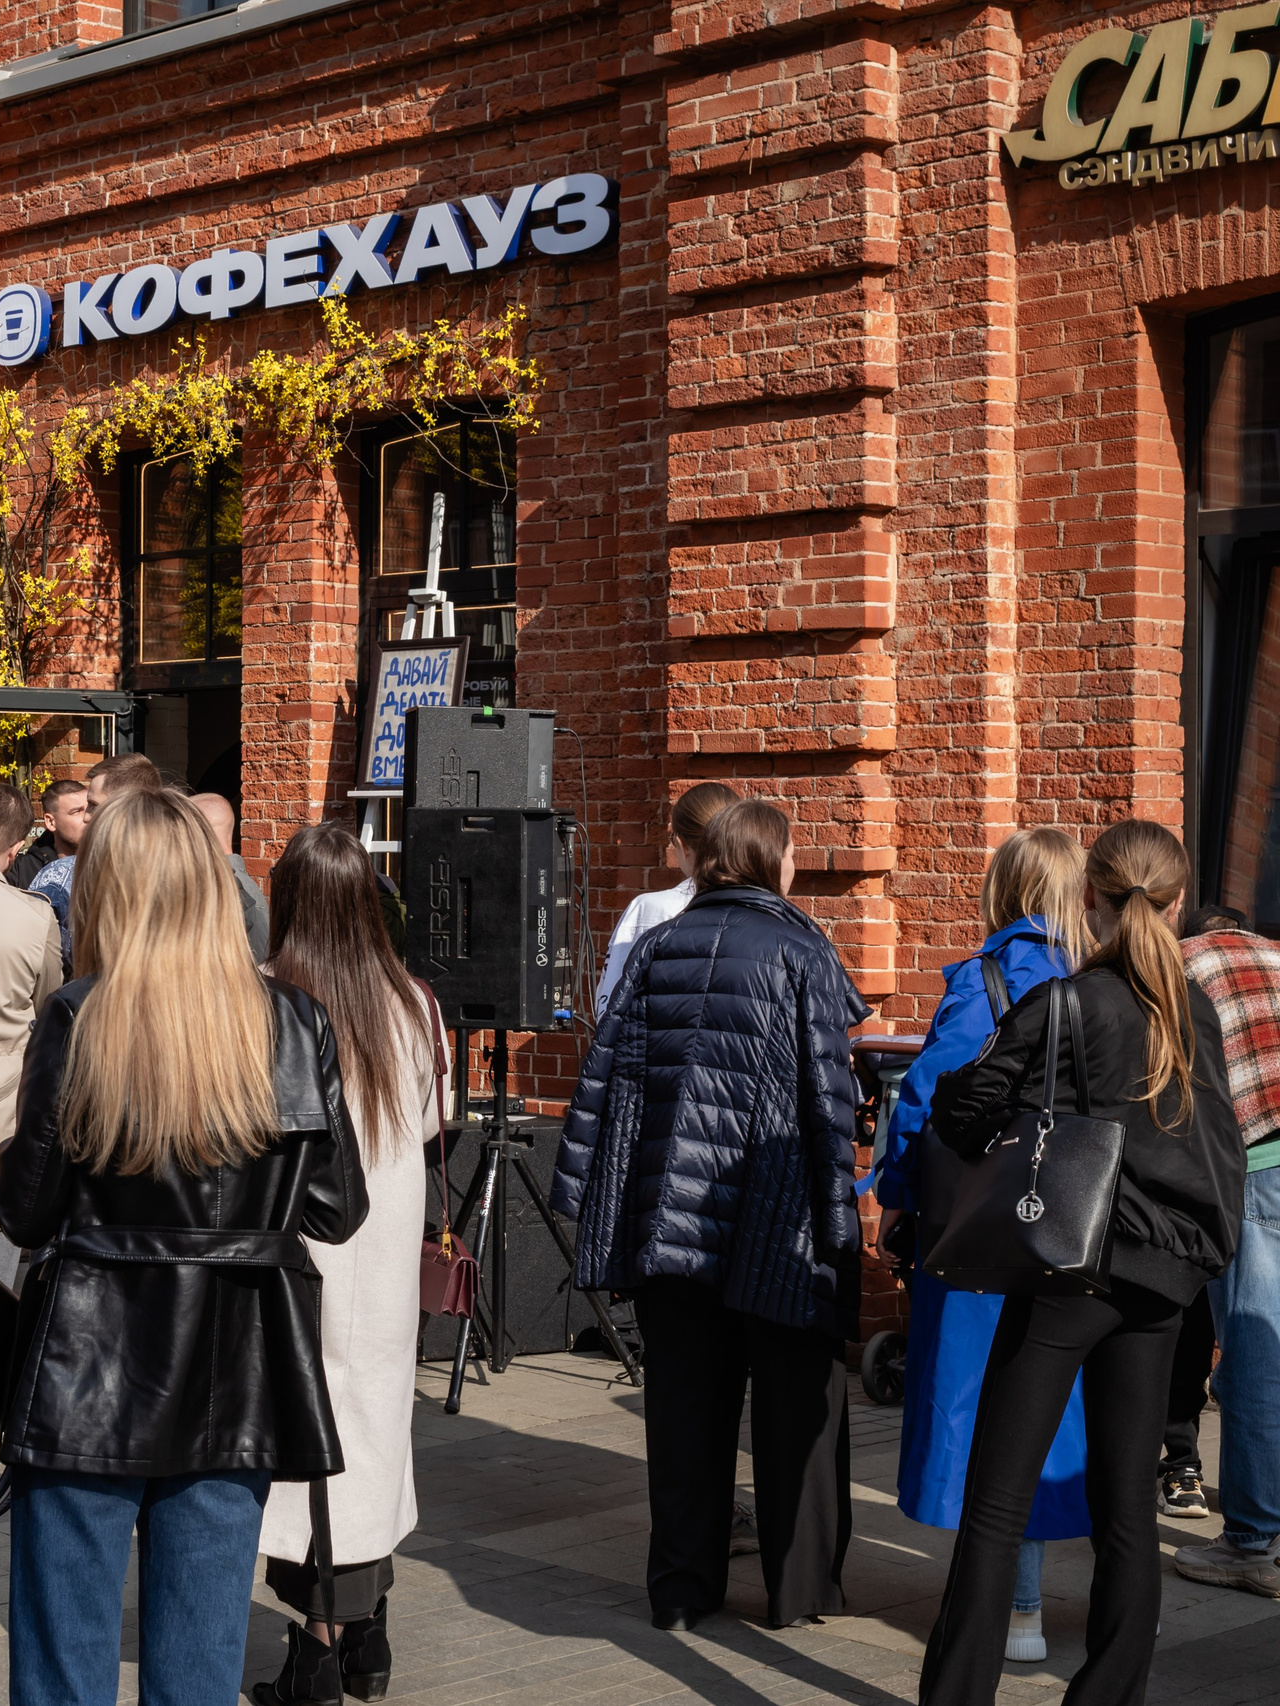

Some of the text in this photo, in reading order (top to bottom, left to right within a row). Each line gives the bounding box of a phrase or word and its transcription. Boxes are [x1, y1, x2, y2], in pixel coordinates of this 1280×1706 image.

[1001, 1, 1280, 168] САБ
[1058, 129, 1278, 190] СЭНДВИЧИ
[63, 172, 613, 348] КОФЕХАУЗ
[384, 650, 452, 689] ДАВАЙ
[429, 854, 452, 984] VERSE
[537, 906, 548, 953] VERSE
